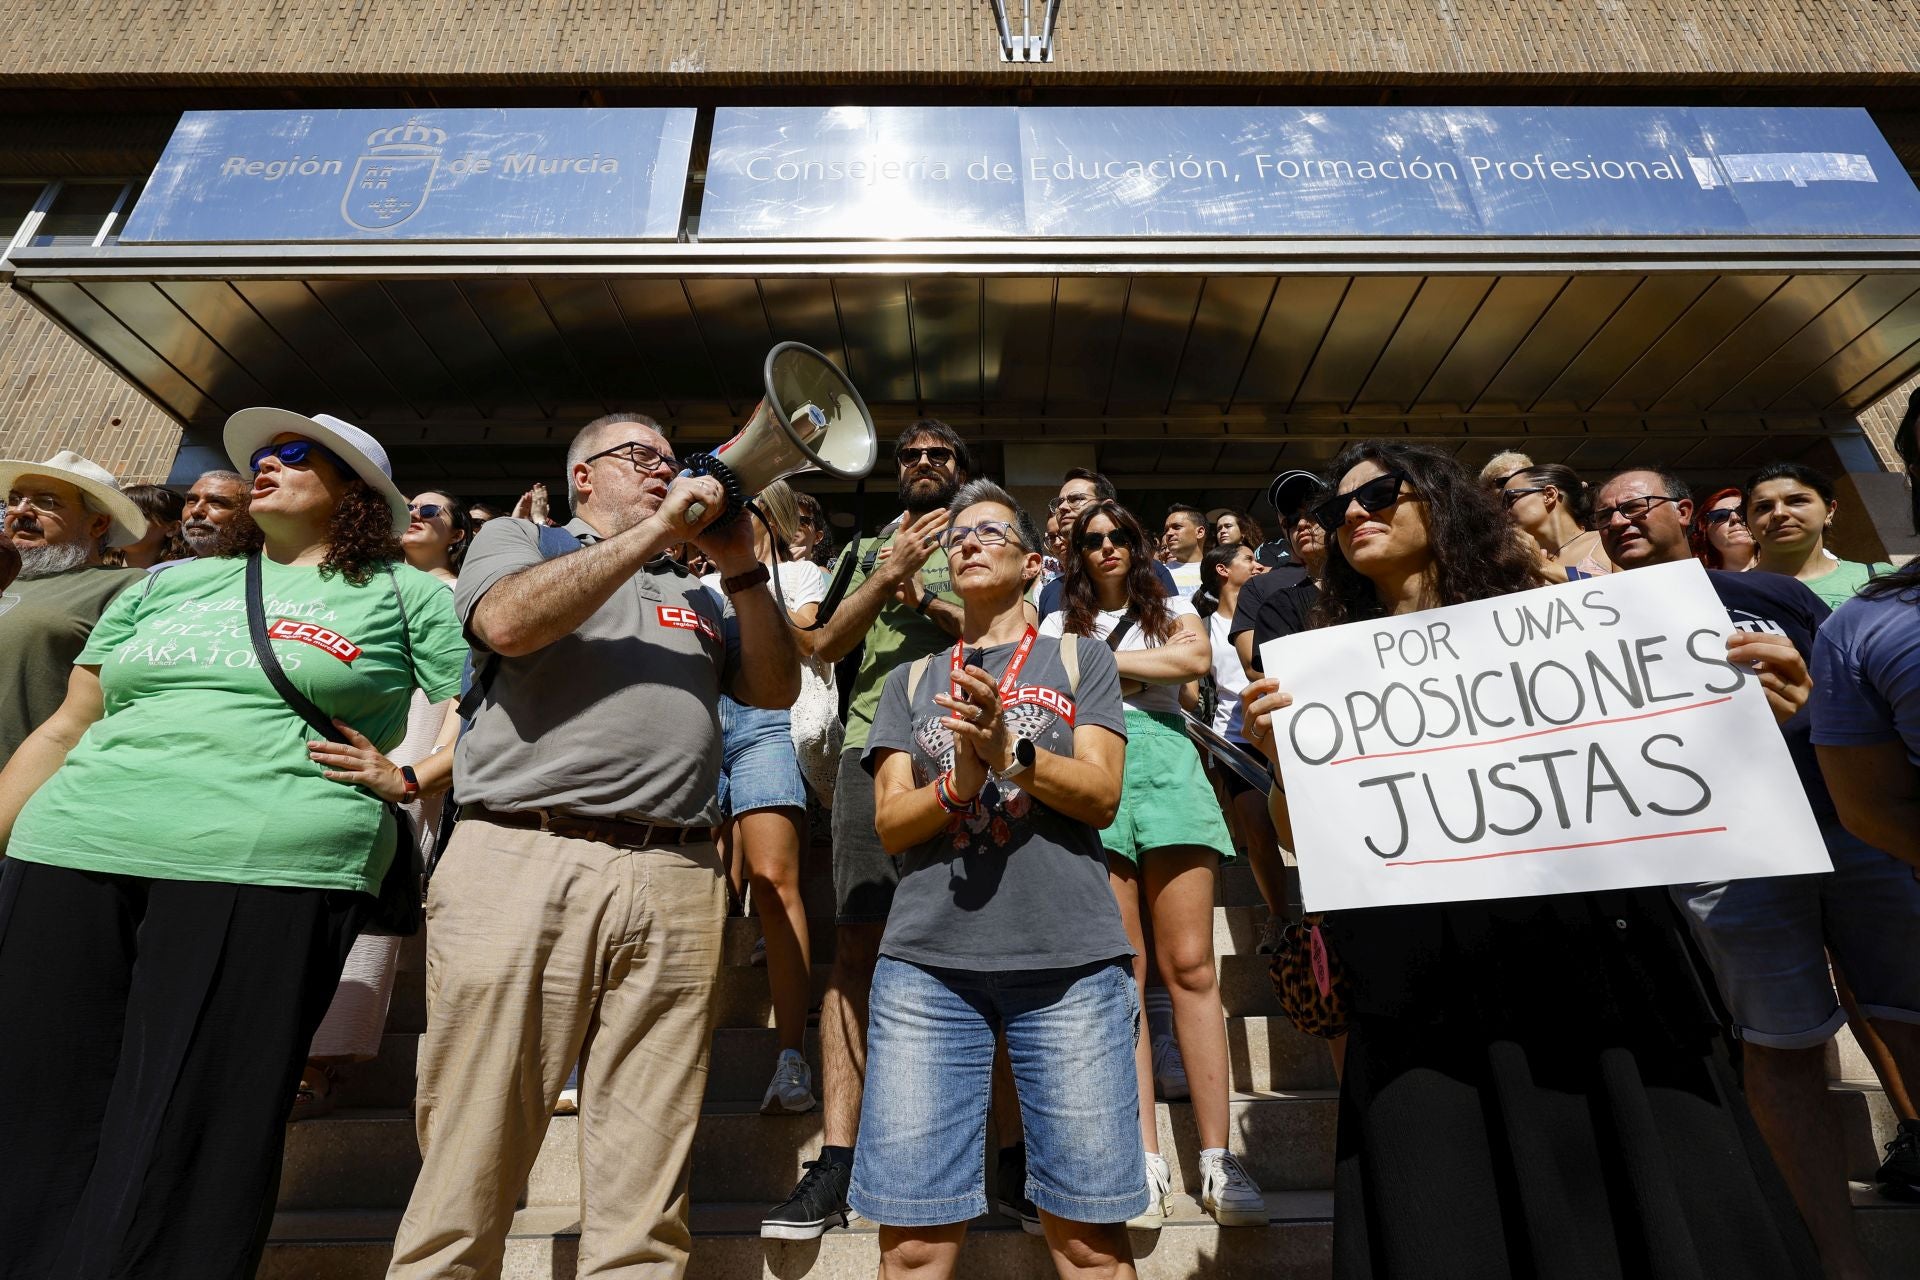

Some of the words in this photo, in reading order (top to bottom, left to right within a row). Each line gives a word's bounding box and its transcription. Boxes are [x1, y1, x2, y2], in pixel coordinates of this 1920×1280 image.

[222, 154, 342, 182] Región
[448, 153, 491, 175] de
[503, 153, 620, 176] Murcia
[746, 155, 951, 187] Consejería
[967, 154, 1014, 182] de
[1031, 153, 1242, 184] Educación,
[1255, 153, 1458, 181] Formación
[1470, 153, 1684, 182] Profesional
[119, 643, 198, 665] PARA
[1373, 621, 1460, 669] POR
[1493, 590, 1621, 647] UNAS
[1288, 629, 1747, 766] OPOSICIONES
[1357, 733, 1713, 859] JUSTAS
